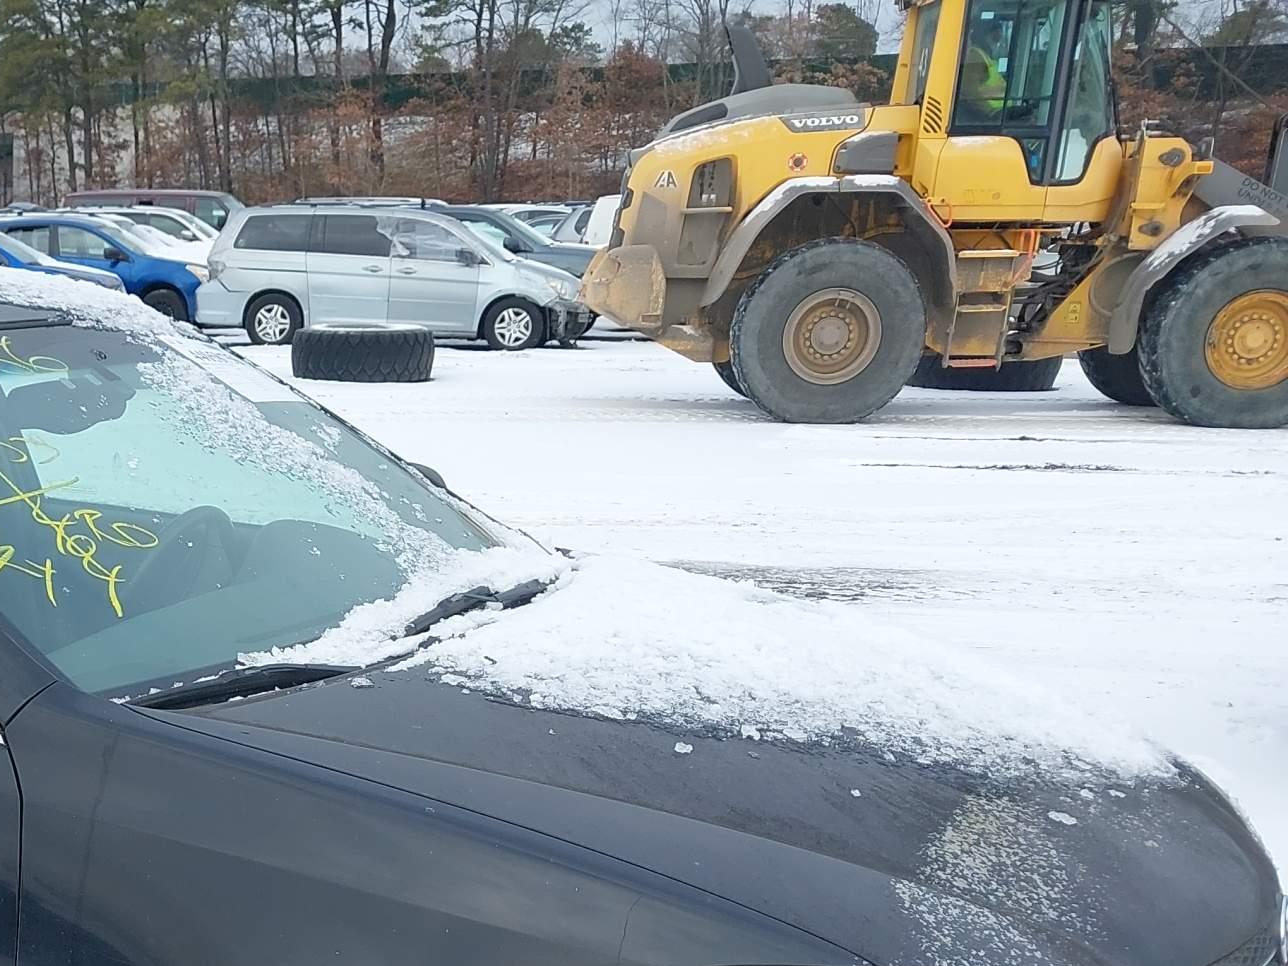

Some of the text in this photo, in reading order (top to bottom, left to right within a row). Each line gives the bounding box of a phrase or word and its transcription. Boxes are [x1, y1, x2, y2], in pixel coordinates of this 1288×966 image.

[790, 115, 859, 128] VOLVO
[1241, 177, 1283, 202] DO NOT
